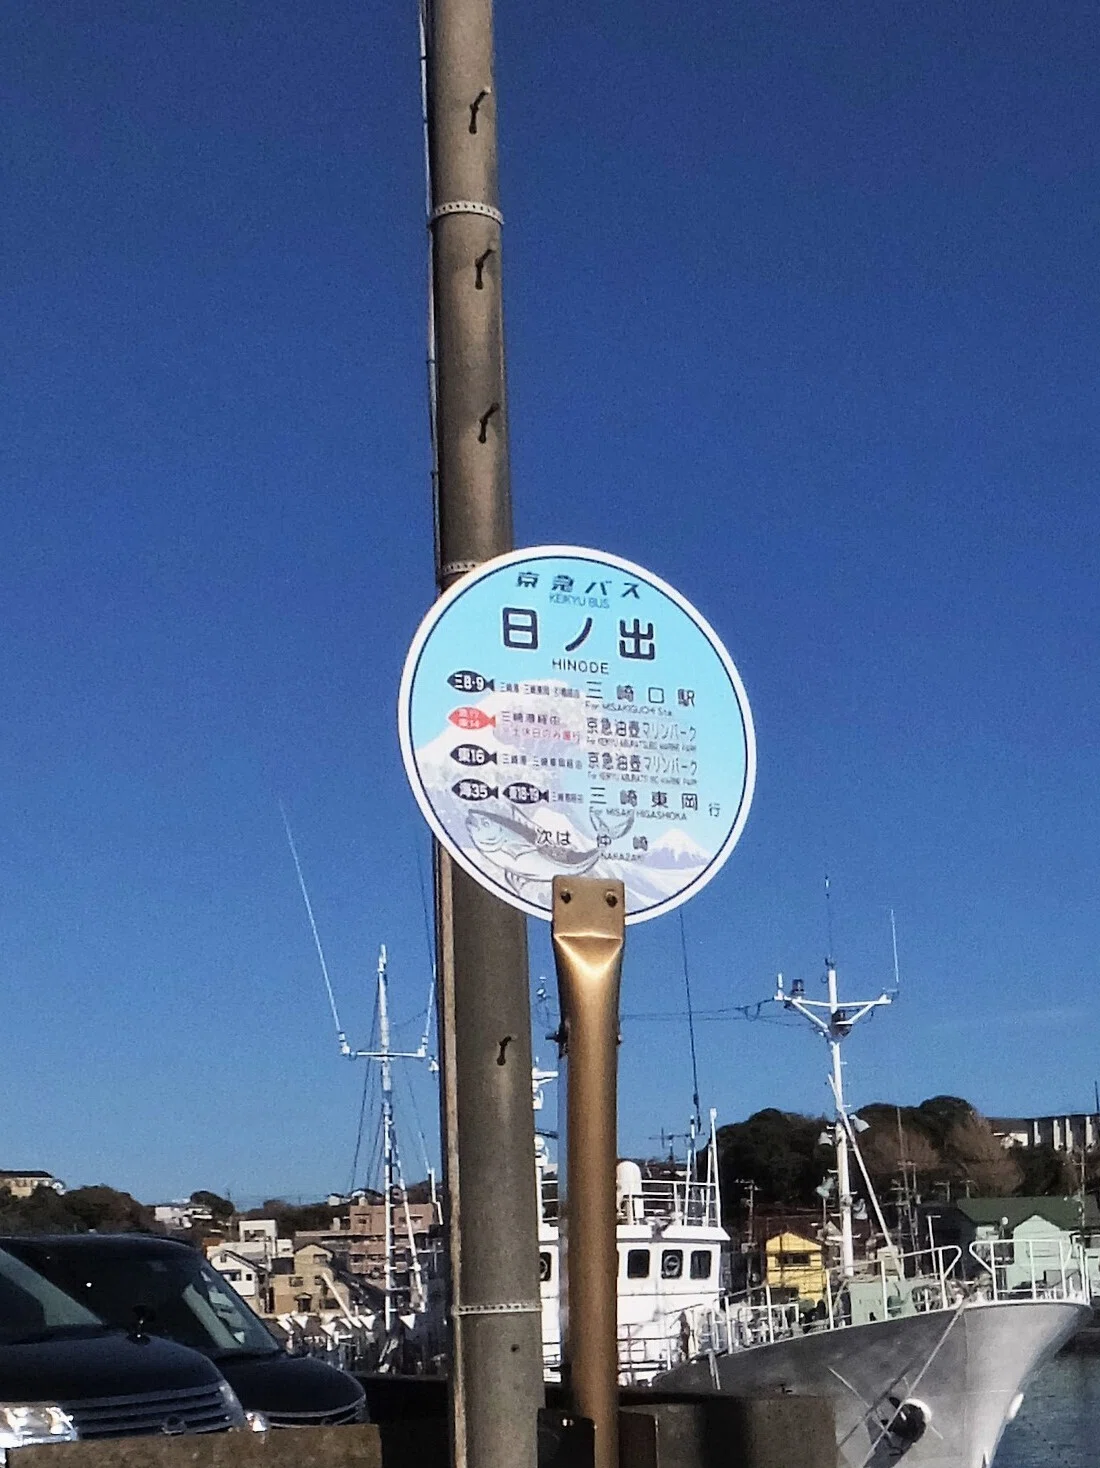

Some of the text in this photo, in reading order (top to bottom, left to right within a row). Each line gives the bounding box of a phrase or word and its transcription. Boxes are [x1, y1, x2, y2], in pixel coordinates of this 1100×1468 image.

[516, 571, 641, 600] 京急バス
[589, 597, 610, 609] BUS
[502, 606, 656, 661] 日ノ出
[552, 658, 609, 675] HINODE
[585, 681, 695, 708] 三崎口駅
[589, 787, 721, 818] 三崎東岡 行
[536, 828, 571, 847] 次は
